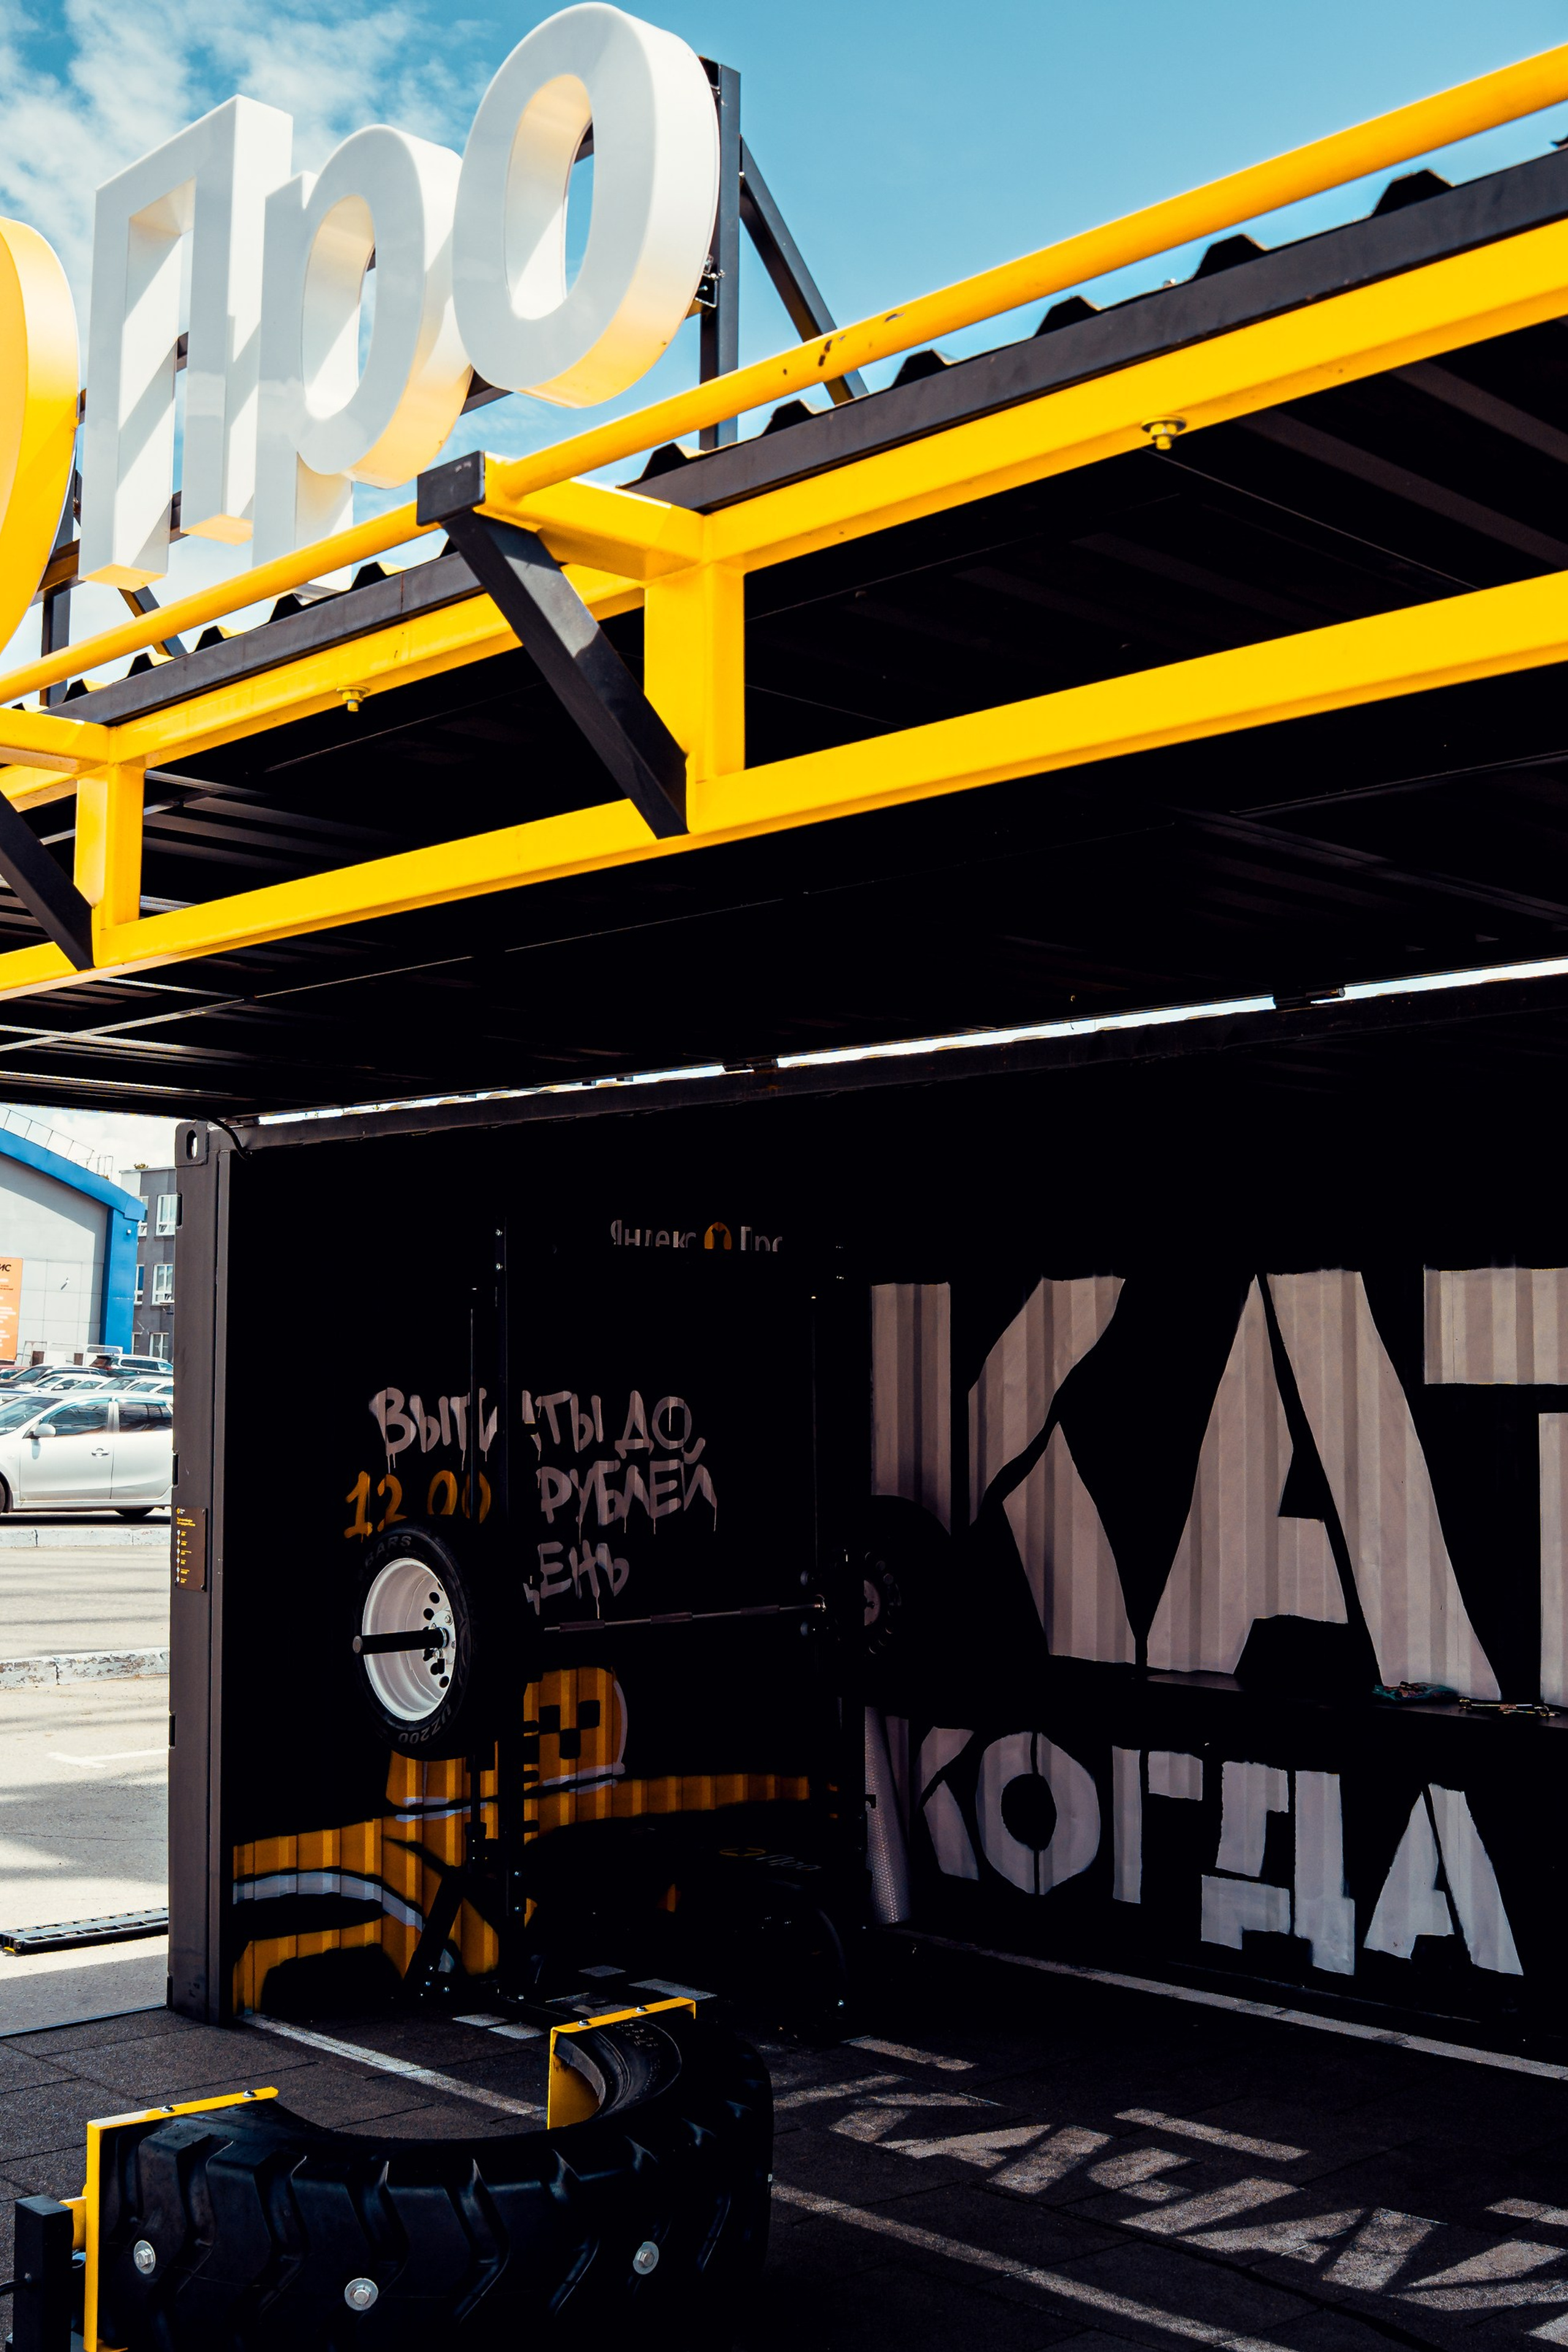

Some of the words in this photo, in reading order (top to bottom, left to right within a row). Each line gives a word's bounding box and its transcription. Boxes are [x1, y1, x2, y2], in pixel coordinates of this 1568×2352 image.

[78, 1, 720, 592] Про
[614, 1390, 692, 1460] ДО
[885, 1714, 1525, 1977] КОГДА
